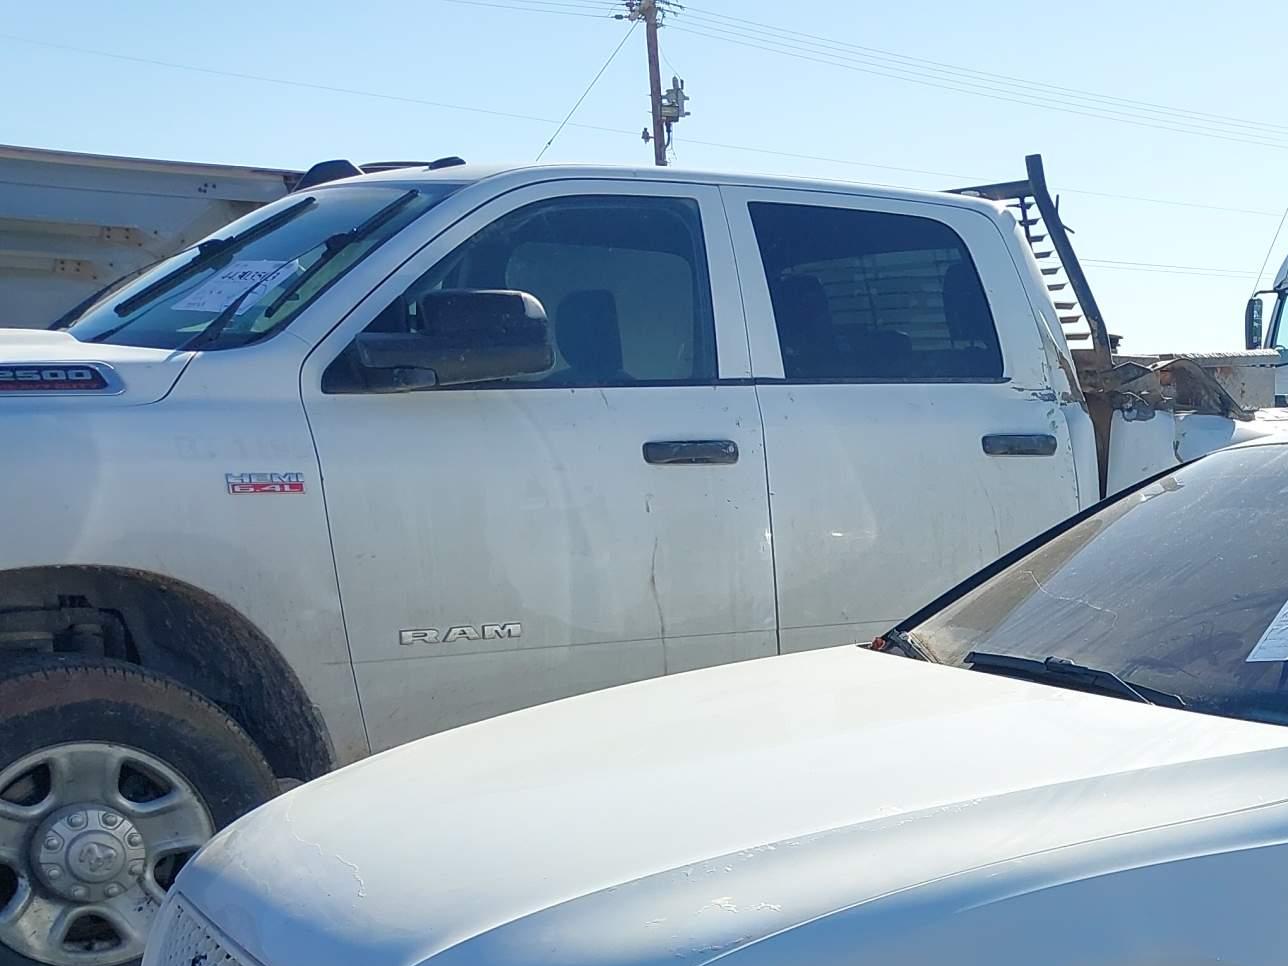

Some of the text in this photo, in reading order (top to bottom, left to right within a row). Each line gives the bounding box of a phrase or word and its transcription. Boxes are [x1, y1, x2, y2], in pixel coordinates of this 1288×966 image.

[225, 473, 304, 483] HEMI
[233, 483, 303, 493] 6.4L
[399, 622, 521, 645] RAM
